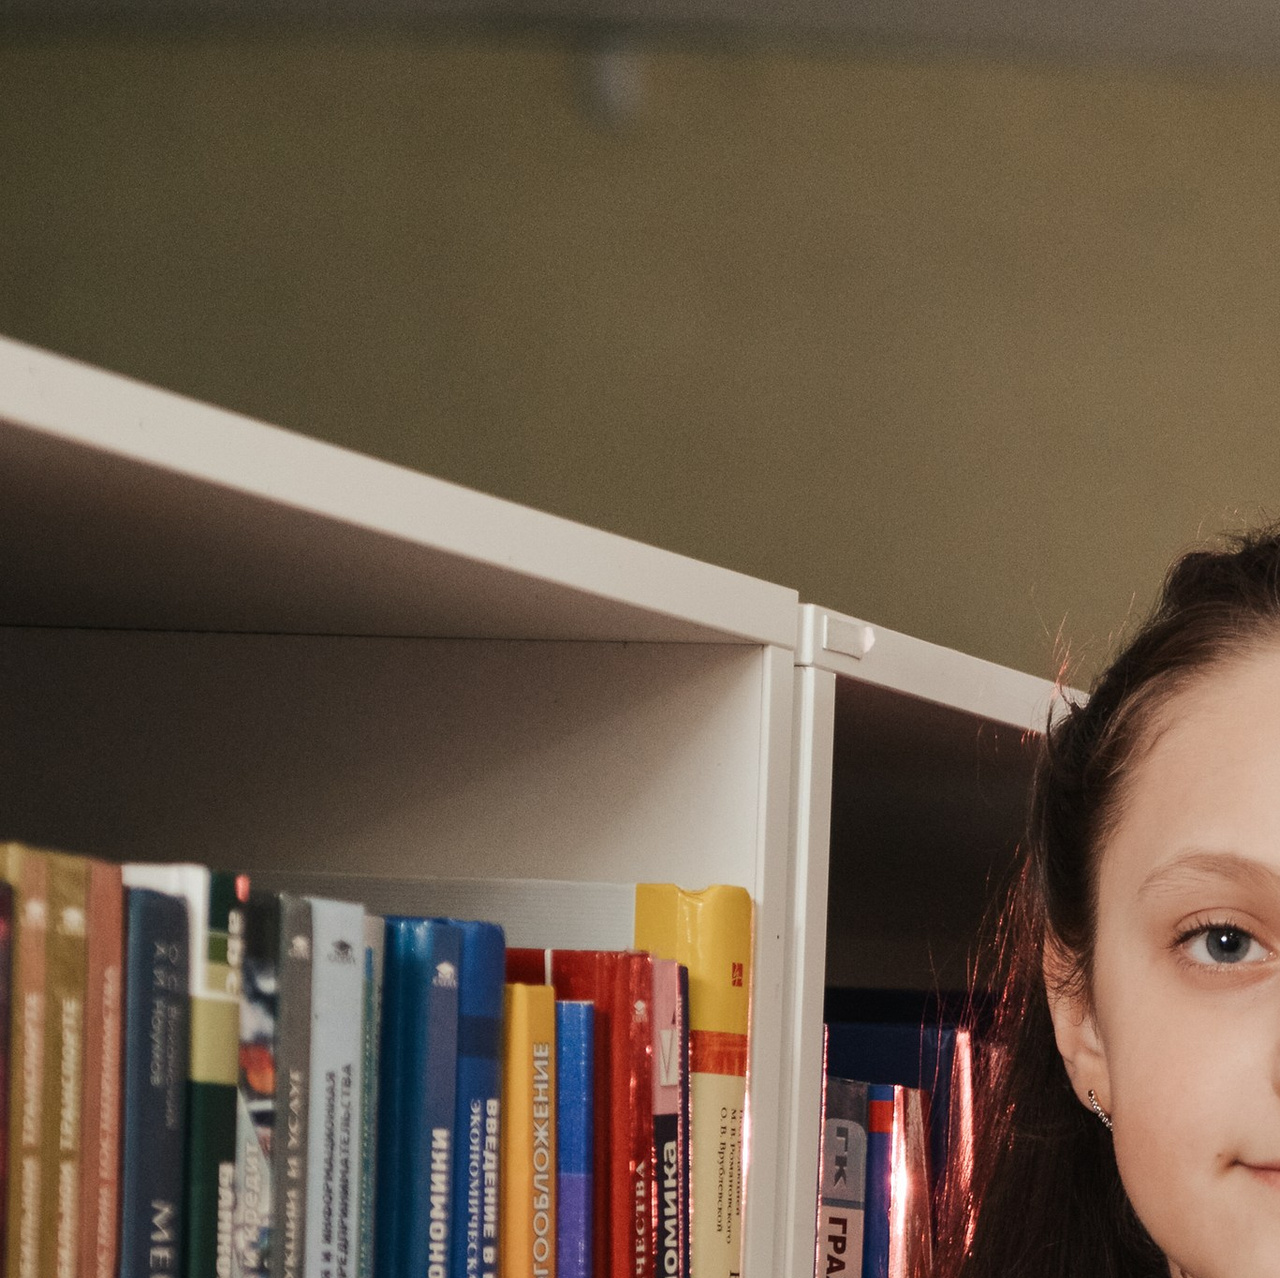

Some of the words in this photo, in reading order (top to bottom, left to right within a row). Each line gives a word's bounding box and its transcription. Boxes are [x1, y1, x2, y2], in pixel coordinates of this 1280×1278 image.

[286, 1067, 302, 1149] УСЛУГ
[719, 1106, 728, 1123] О.
[719, 1125, 727, 1142] В.
[286, 1157, 300, 1179] И
[320, 1071, 337, 1245] ИНФОРМАЦИОННАЯ
[481, 1098, 499, 1239] ВВЕДЕНИЕ
[715, 1145, 727, 1233] Врублевской
[833, 1125, 850, 1190] ГК
[724, 1146, 735, 1244] Романовского
[320, 1251, 331, 1263] И
[481, 1246, 495, 1264] В
